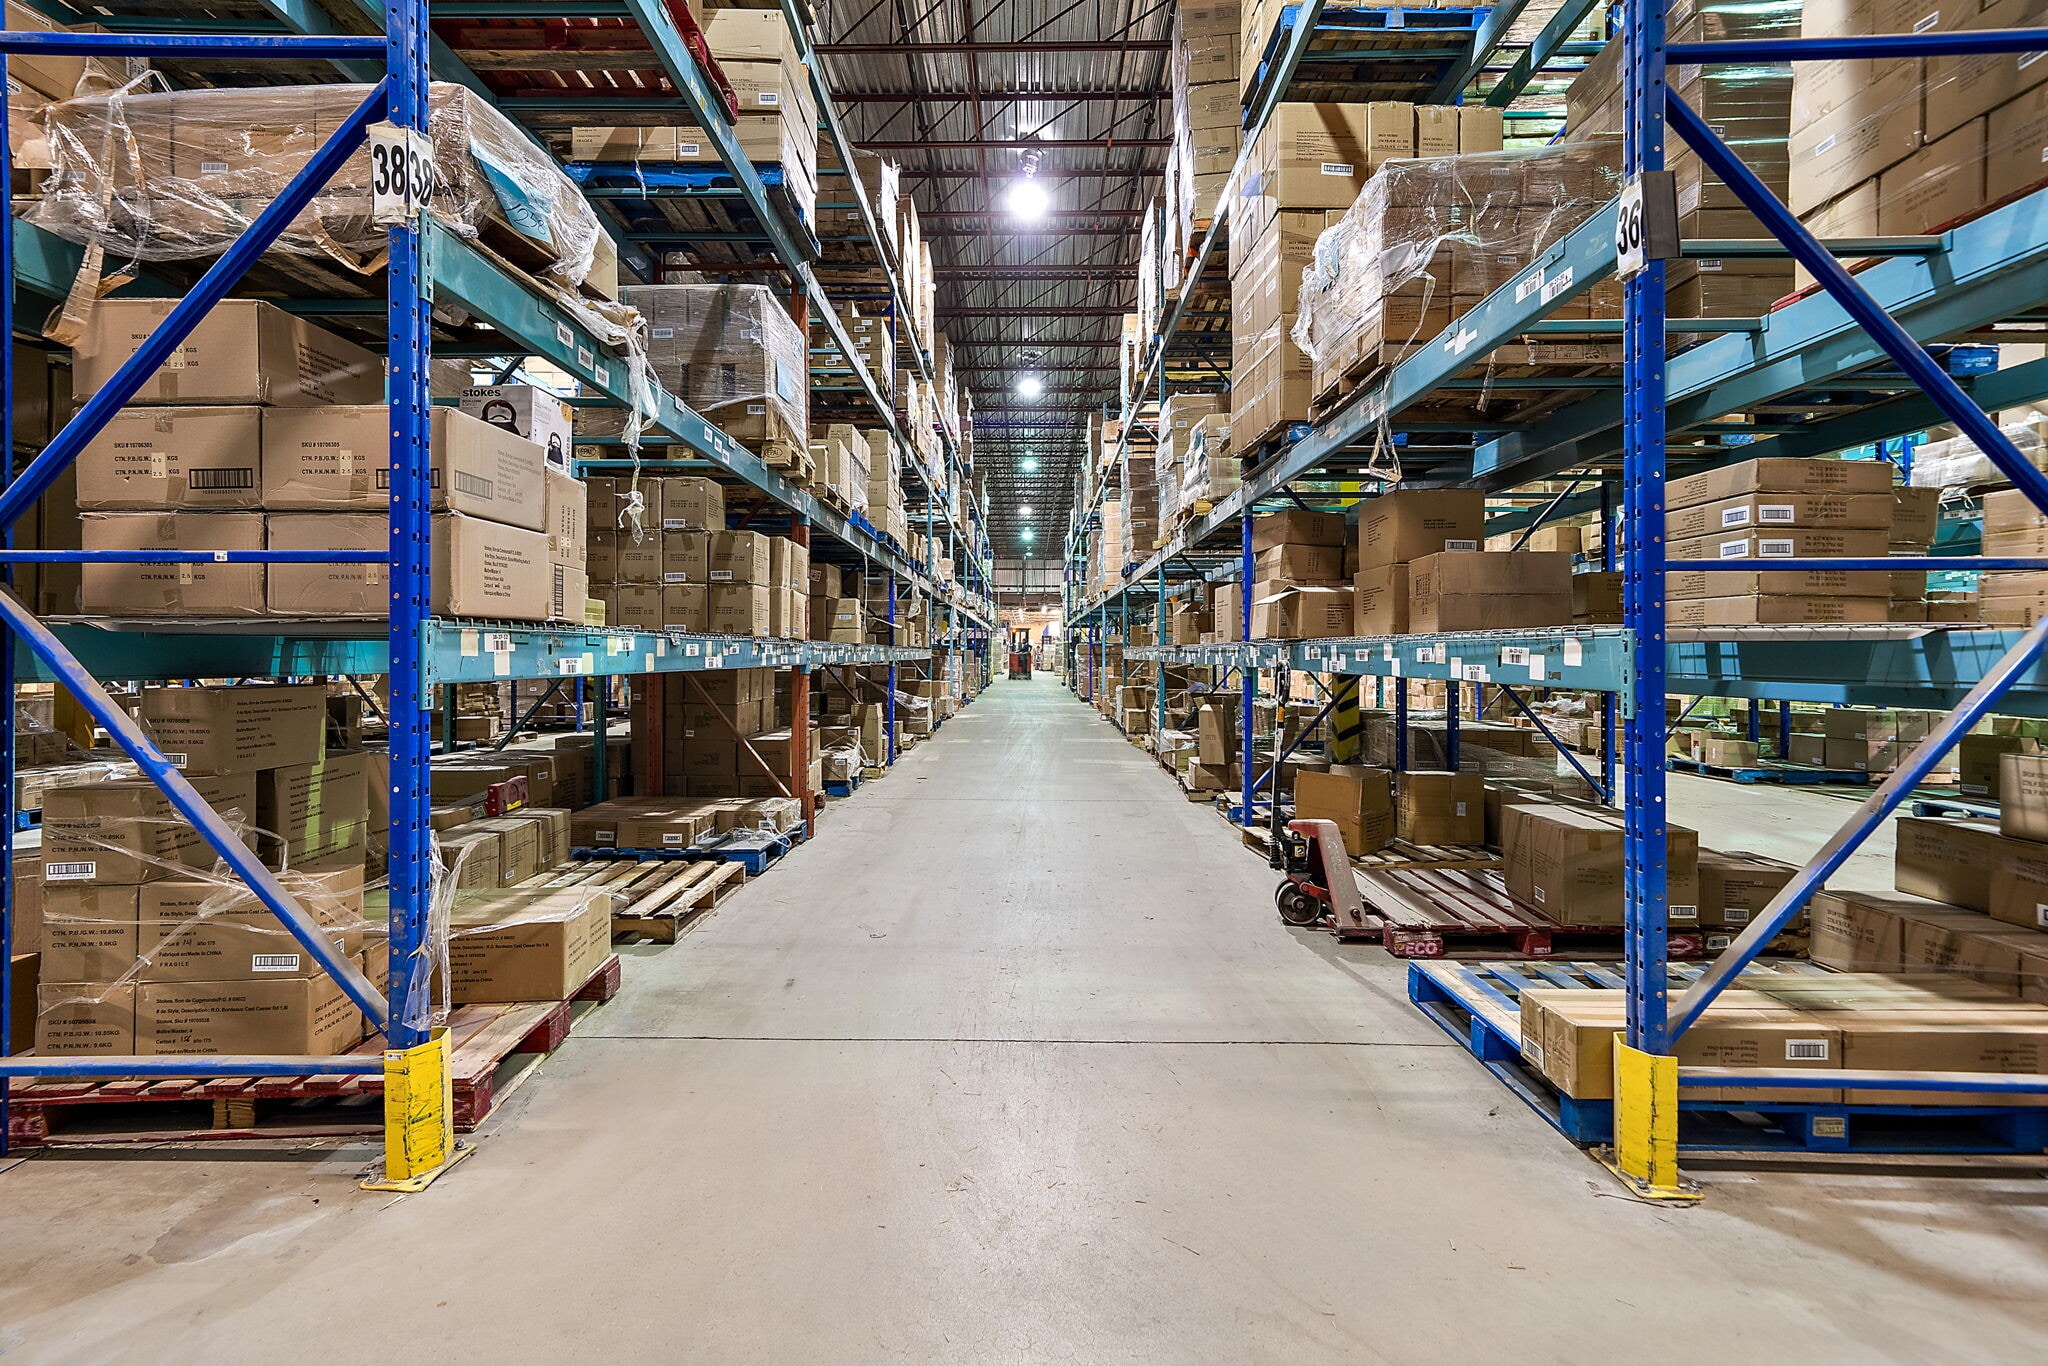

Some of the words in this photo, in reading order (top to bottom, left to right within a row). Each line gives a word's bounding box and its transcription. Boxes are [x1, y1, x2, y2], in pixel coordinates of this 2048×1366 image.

[373, 143, 406, 196] 38
[409, 150, 433, 207] 38
[1616, 198, 1641, 256] 36
[462, 388, 501, 397] stokes
